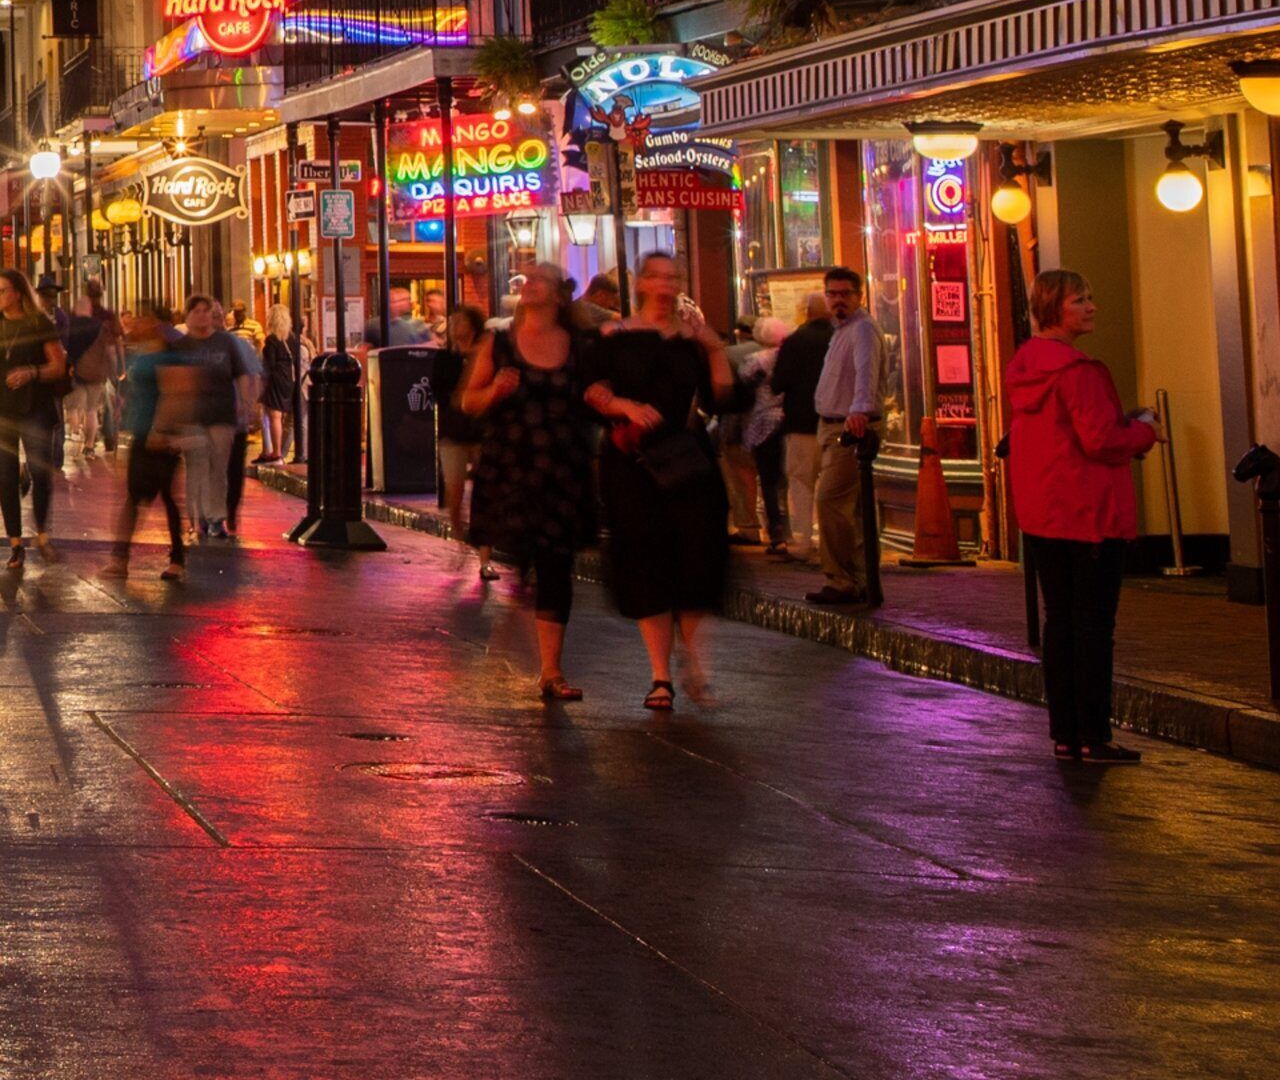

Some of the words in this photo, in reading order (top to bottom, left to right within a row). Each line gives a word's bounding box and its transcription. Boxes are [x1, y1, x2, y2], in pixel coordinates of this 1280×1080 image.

[218, 21, 251, 36] CAFE
[570, 52, 606, 82] Olde
[588, 55, 710, 100] NOL
[421, 120, 509, 147] MNGO
[645, 131, 688, 148] Gumbo
[635, 150, 682, 169] Seafood
[686, 148, 730, 169] Oysters
[152, 176, 193, 197] Hard
[195, 177, 236, 198] Rock
[411, 172, 540, 200] DAQUIRIS
[183, 197, 206, 208] CAFE
[422, 198, 470, 214] PIZA
[492, 191, 531, 208] SLICE
[679, 191, 740, 207] CUISINE
